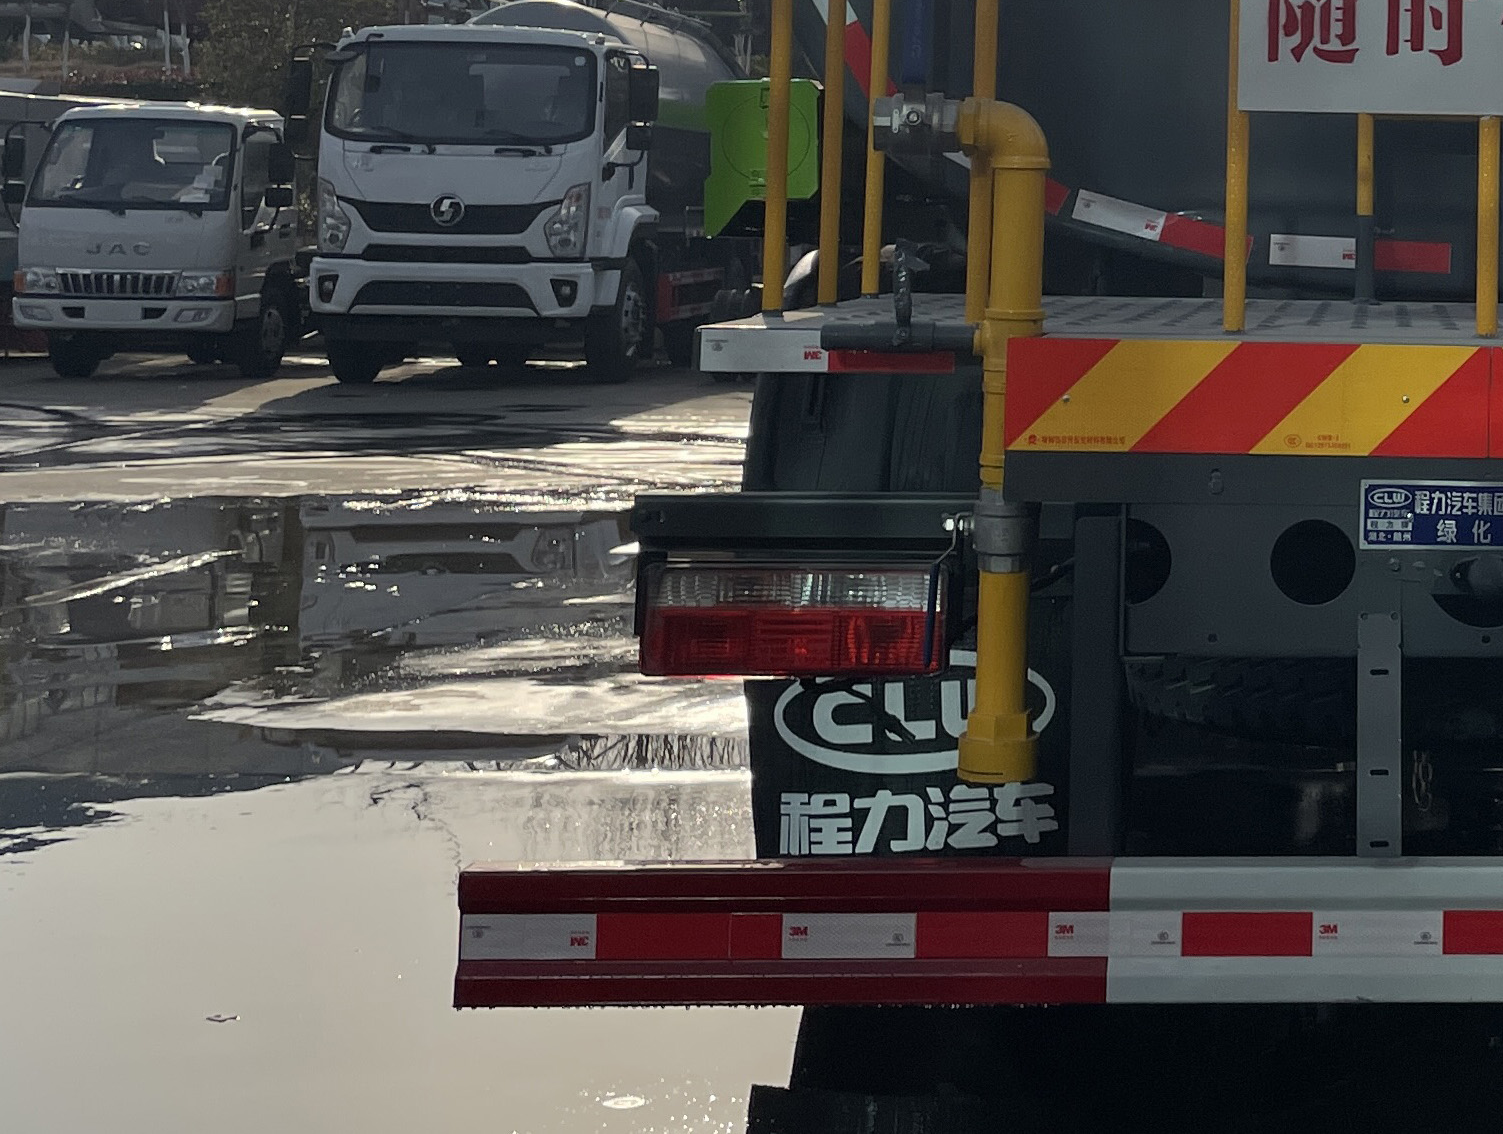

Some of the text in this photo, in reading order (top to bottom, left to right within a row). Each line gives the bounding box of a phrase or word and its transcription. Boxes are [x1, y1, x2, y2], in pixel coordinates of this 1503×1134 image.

[86, 242, 152, 256] JAC
[1373, 492, 1405, 503] CLW
[779, 782, 1059, 856] 程力汽车
[789, 926, 808, 937] 3M
[1056, 925, 1075, 935] 3M
[1319, 924, 1338, 934] 3M
[570, 936, 589, 946] 3M
